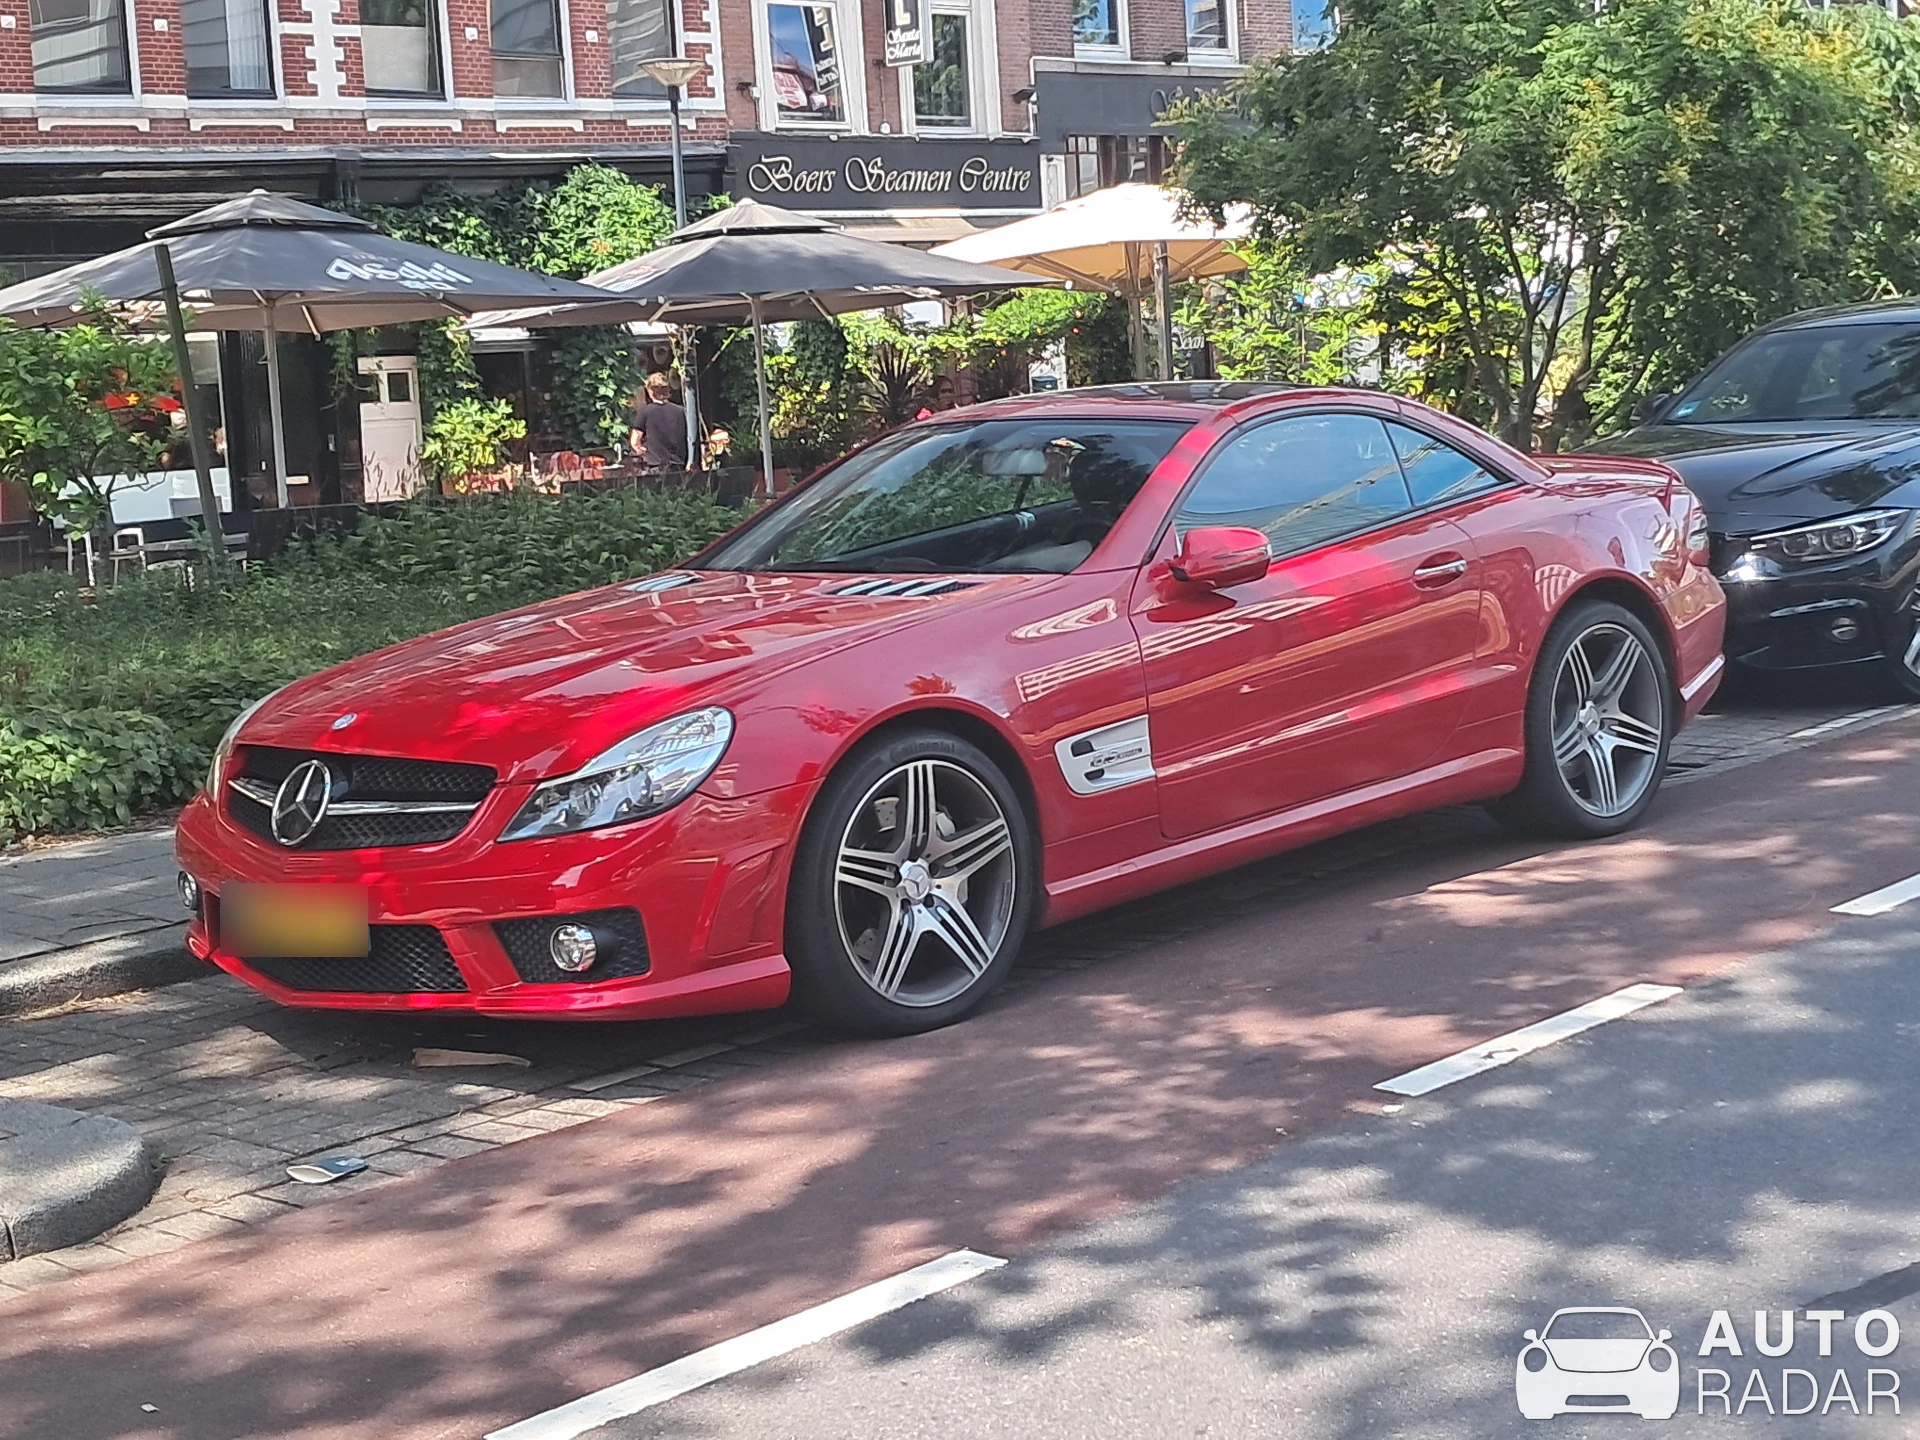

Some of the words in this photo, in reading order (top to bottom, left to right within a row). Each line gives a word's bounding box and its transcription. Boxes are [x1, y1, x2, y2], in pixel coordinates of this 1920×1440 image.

[887, 28, 920, 44] Santa
[887, 43, 921, 59] Maria
[749, 154, 836, 193] Boers
[845, 156, 952, 193] Seamen
[959, 157, 1031, 192] Centre
[325, 257, 474, 284] Asahi
